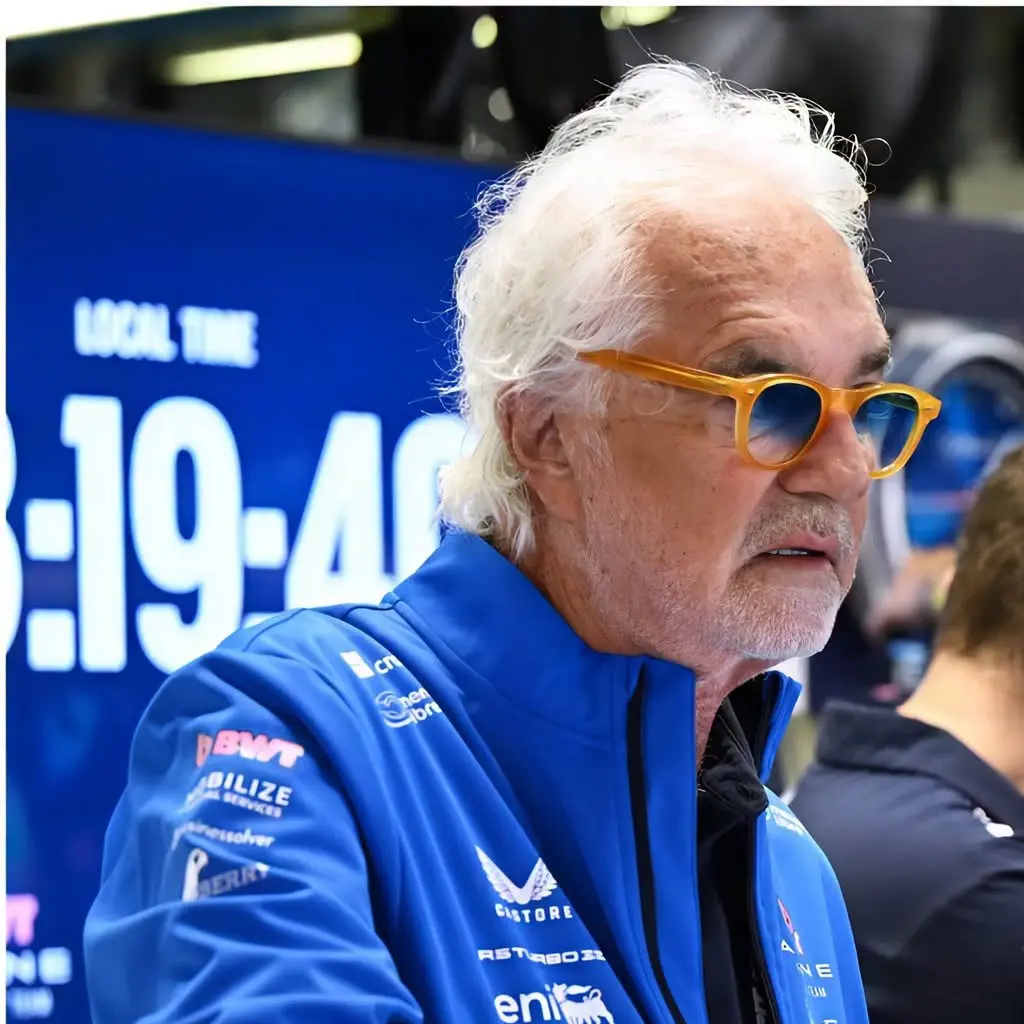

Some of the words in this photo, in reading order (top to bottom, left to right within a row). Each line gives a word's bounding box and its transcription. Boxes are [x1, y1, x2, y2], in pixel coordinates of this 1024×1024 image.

[74, 297, 178, 362] LOCAL
[178, 305, 259, 368] TIME
[212, 729, 305, 769] BWT
[493, 982, 562, 1024] eni
